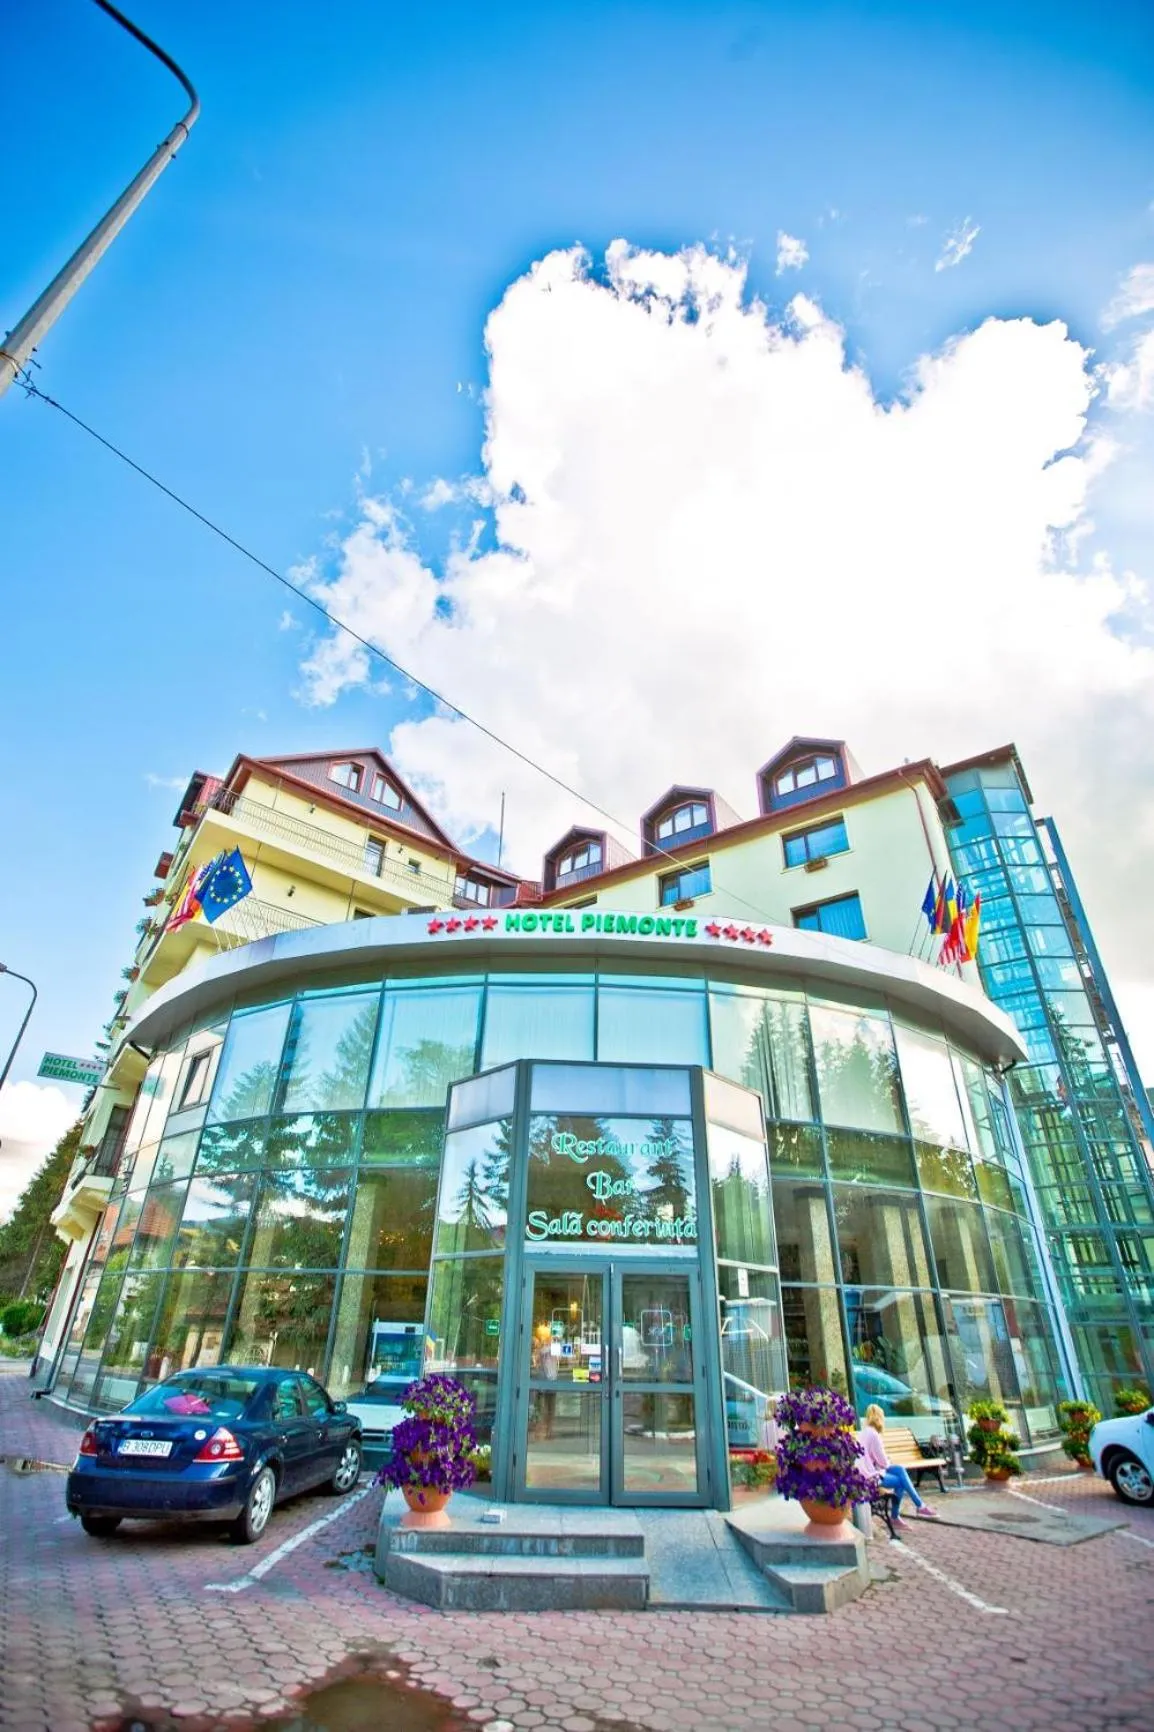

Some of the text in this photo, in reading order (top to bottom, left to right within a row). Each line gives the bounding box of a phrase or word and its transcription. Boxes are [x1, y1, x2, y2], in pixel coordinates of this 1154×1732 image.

[505, 913, 698, 937] HOTEL PIEMONTE
[42, 1065, 100, 1083] PIEMONTE
[44, 1056, 77, 1069] HOTEL
[551, 1132, 674, 1163] Restaurant
[586, 1170, 634, 1205] Bar
